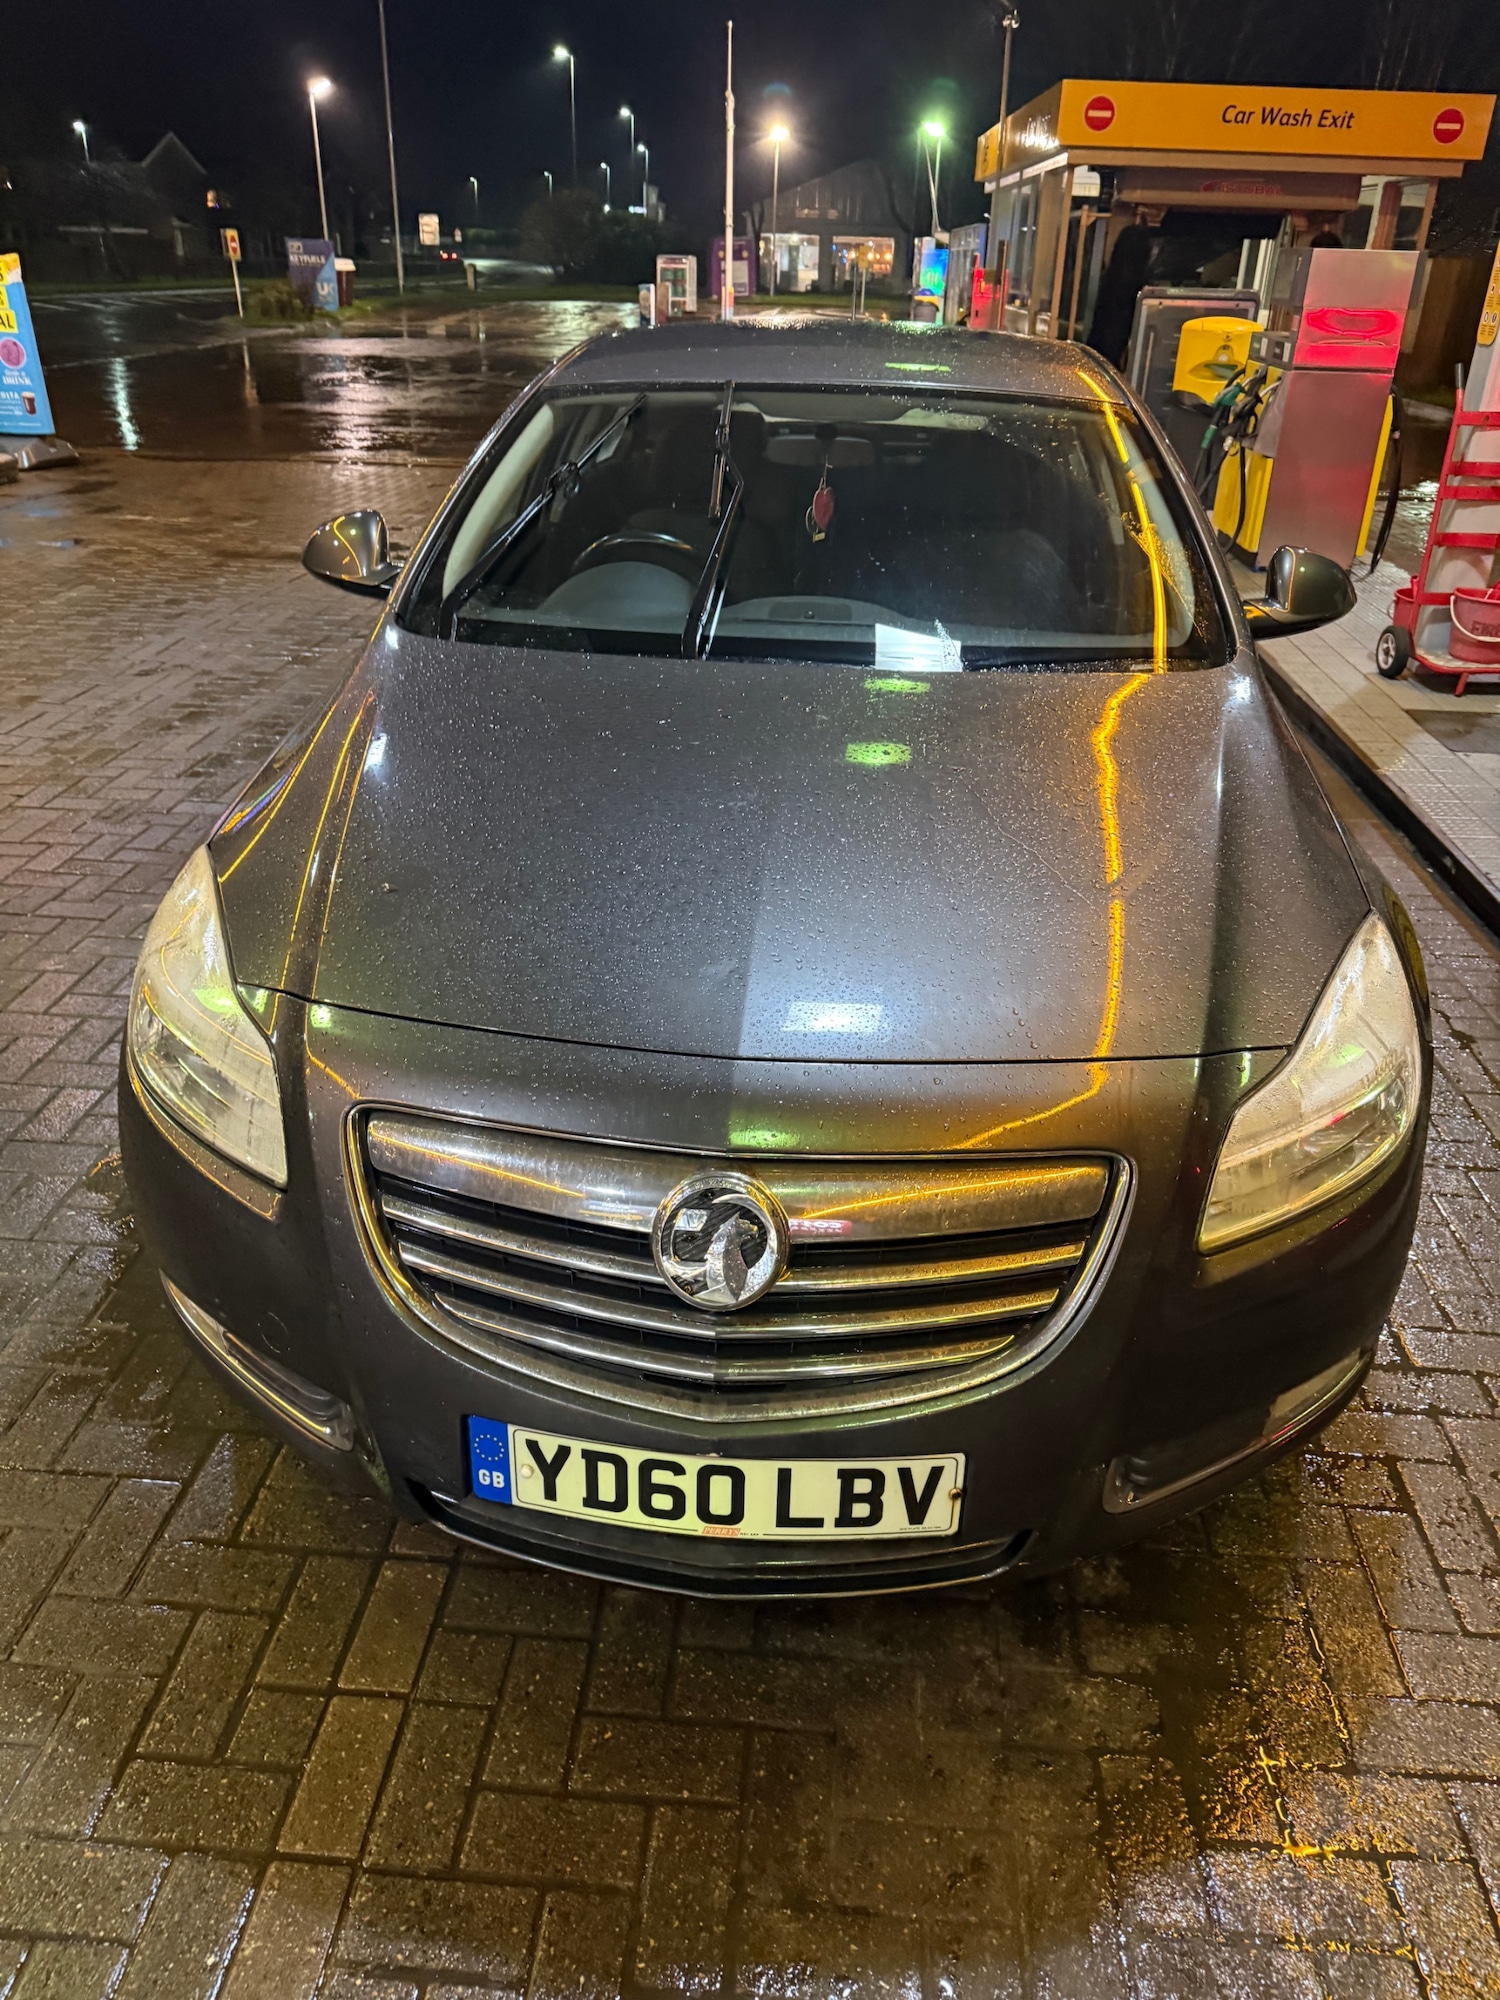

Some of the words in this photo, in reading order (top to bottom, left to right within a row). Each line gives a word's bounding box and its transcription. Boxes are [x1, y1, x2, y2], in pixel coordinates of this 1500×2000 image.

[1222, 104, 1255, 124] Car
[1261, 106, 1313, 127] Wash
[1317, 109, 1355, 129] Exit
[289, 254, 325, 265] KEYFUELS
[478, 1469, 505, 1488] GB
[526, 1439, 745, 1526] YD60
[776, 1465, 945, 1528] LBV
[703, 1526, 740, 1536] PERRYS
